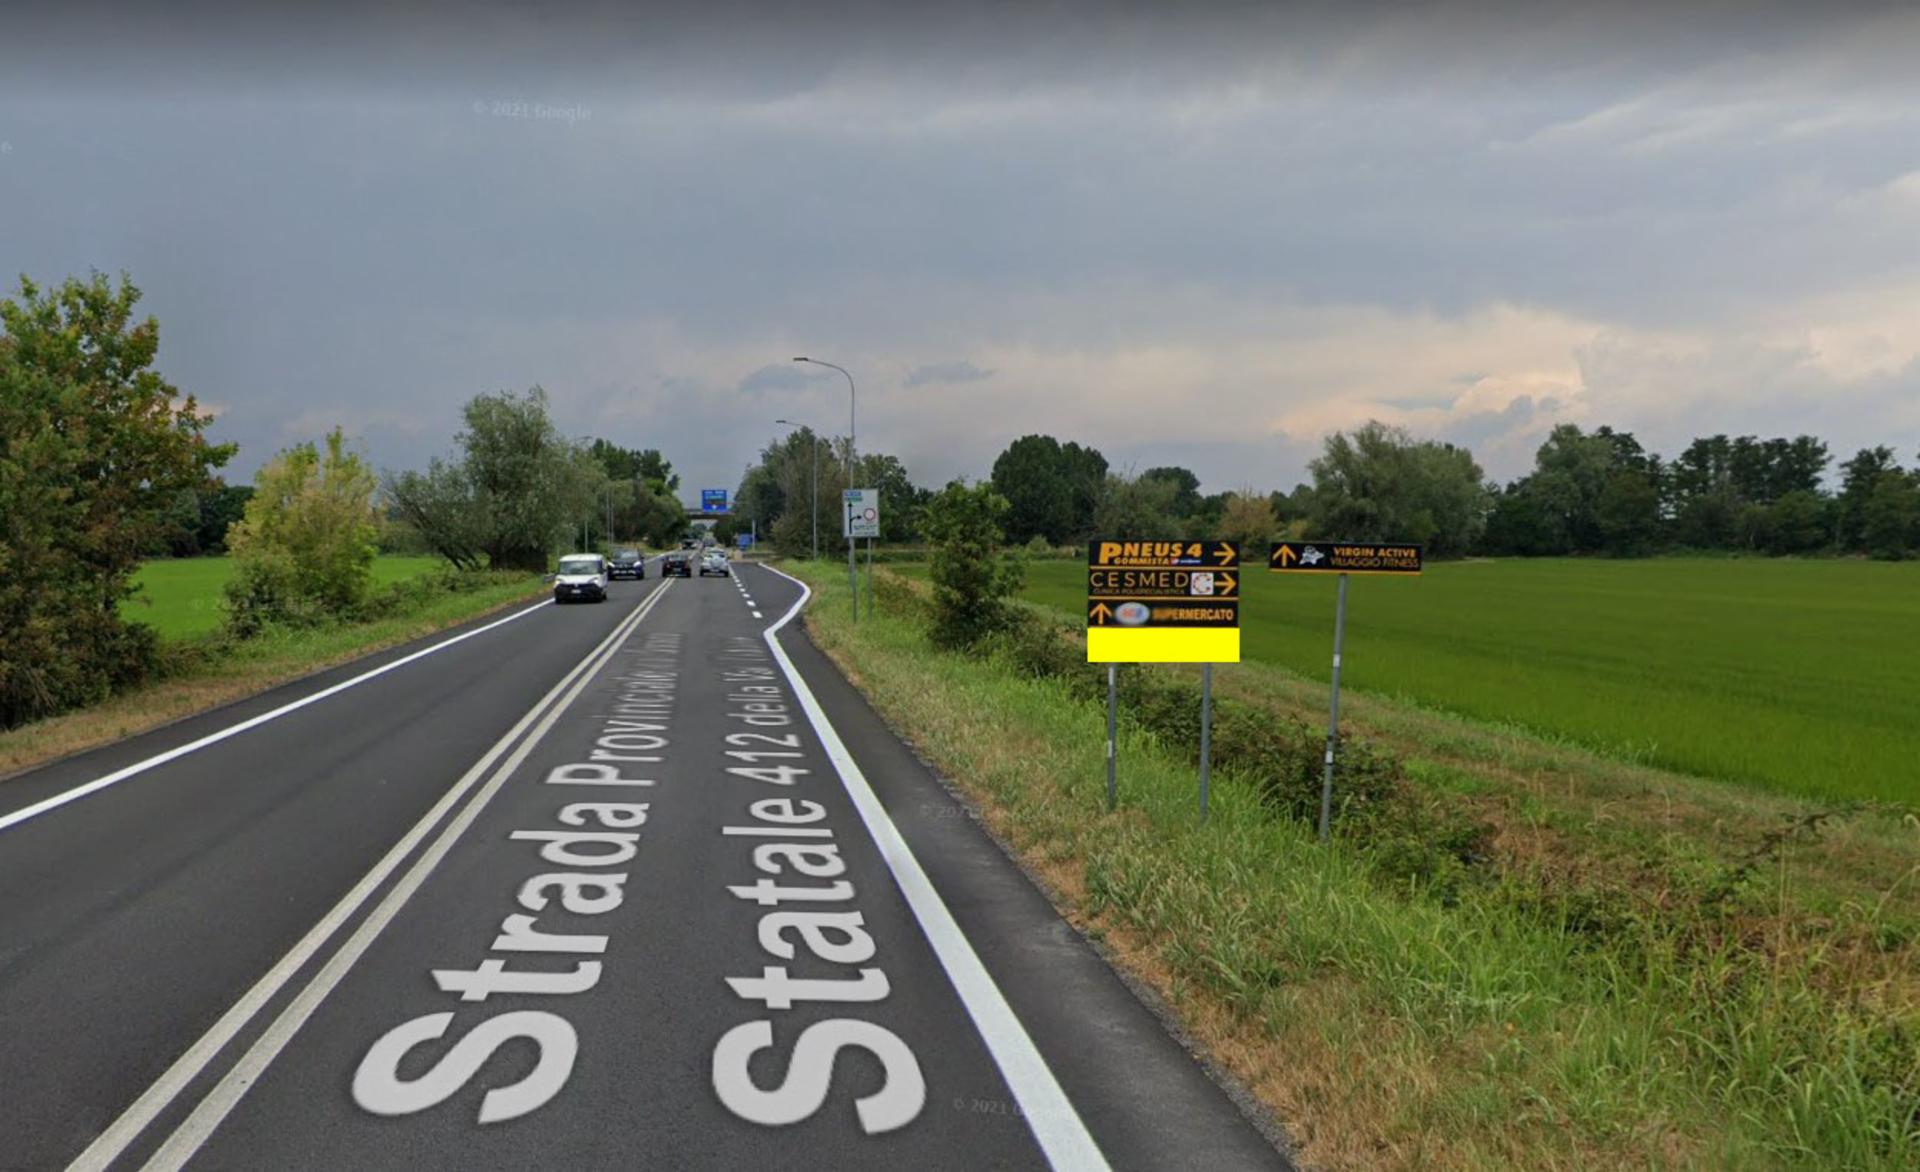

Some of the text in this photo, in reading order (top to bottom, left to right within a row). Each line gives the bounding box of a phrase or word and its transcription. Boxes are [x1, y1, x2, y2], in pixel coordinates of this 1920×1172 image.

[1099, 542, 1202, 564] PNEUS 4
[1333, 546, 1417, 558] VIRGIN ACTIVE
[1113, 557, 1169, 565] GOMMISTA
[1330, 557, 1419, 568] VILLAGGIO FITNESS
[1090, 571, 1190, 588] CESMED
